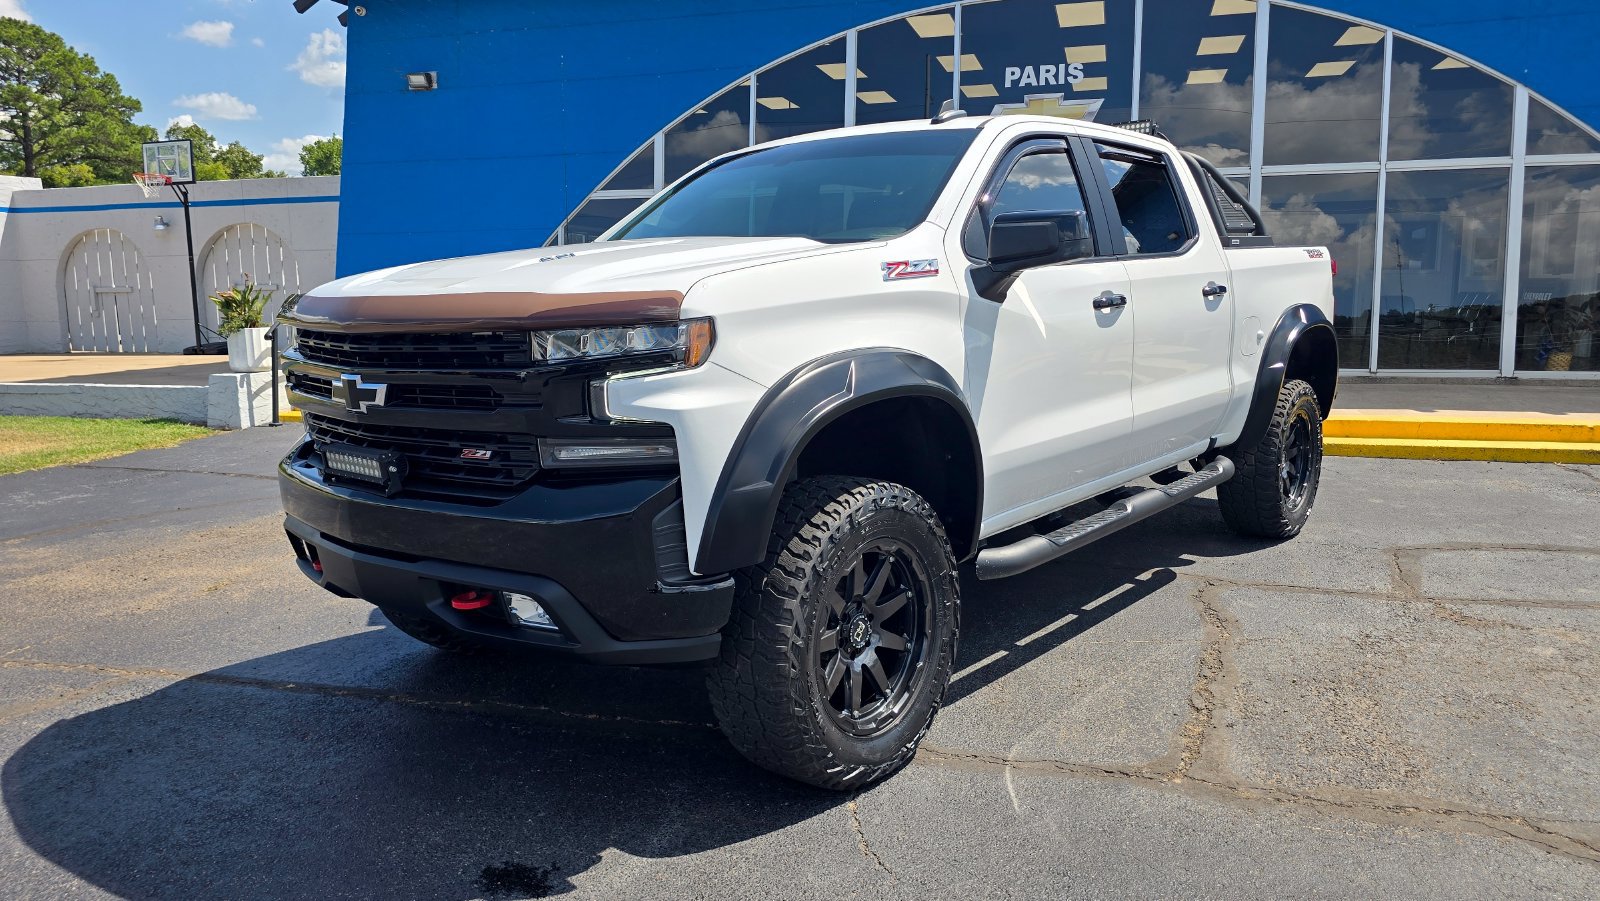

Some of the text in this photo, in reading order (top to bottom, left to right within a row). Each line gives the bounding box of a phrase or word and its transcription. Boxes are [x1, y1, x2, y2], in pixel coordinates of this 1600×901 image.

[1005, 63, 1084, 87] PARIS
[881, 258, 939, 282] Z71
[460, 449, 491, 459] Z71
